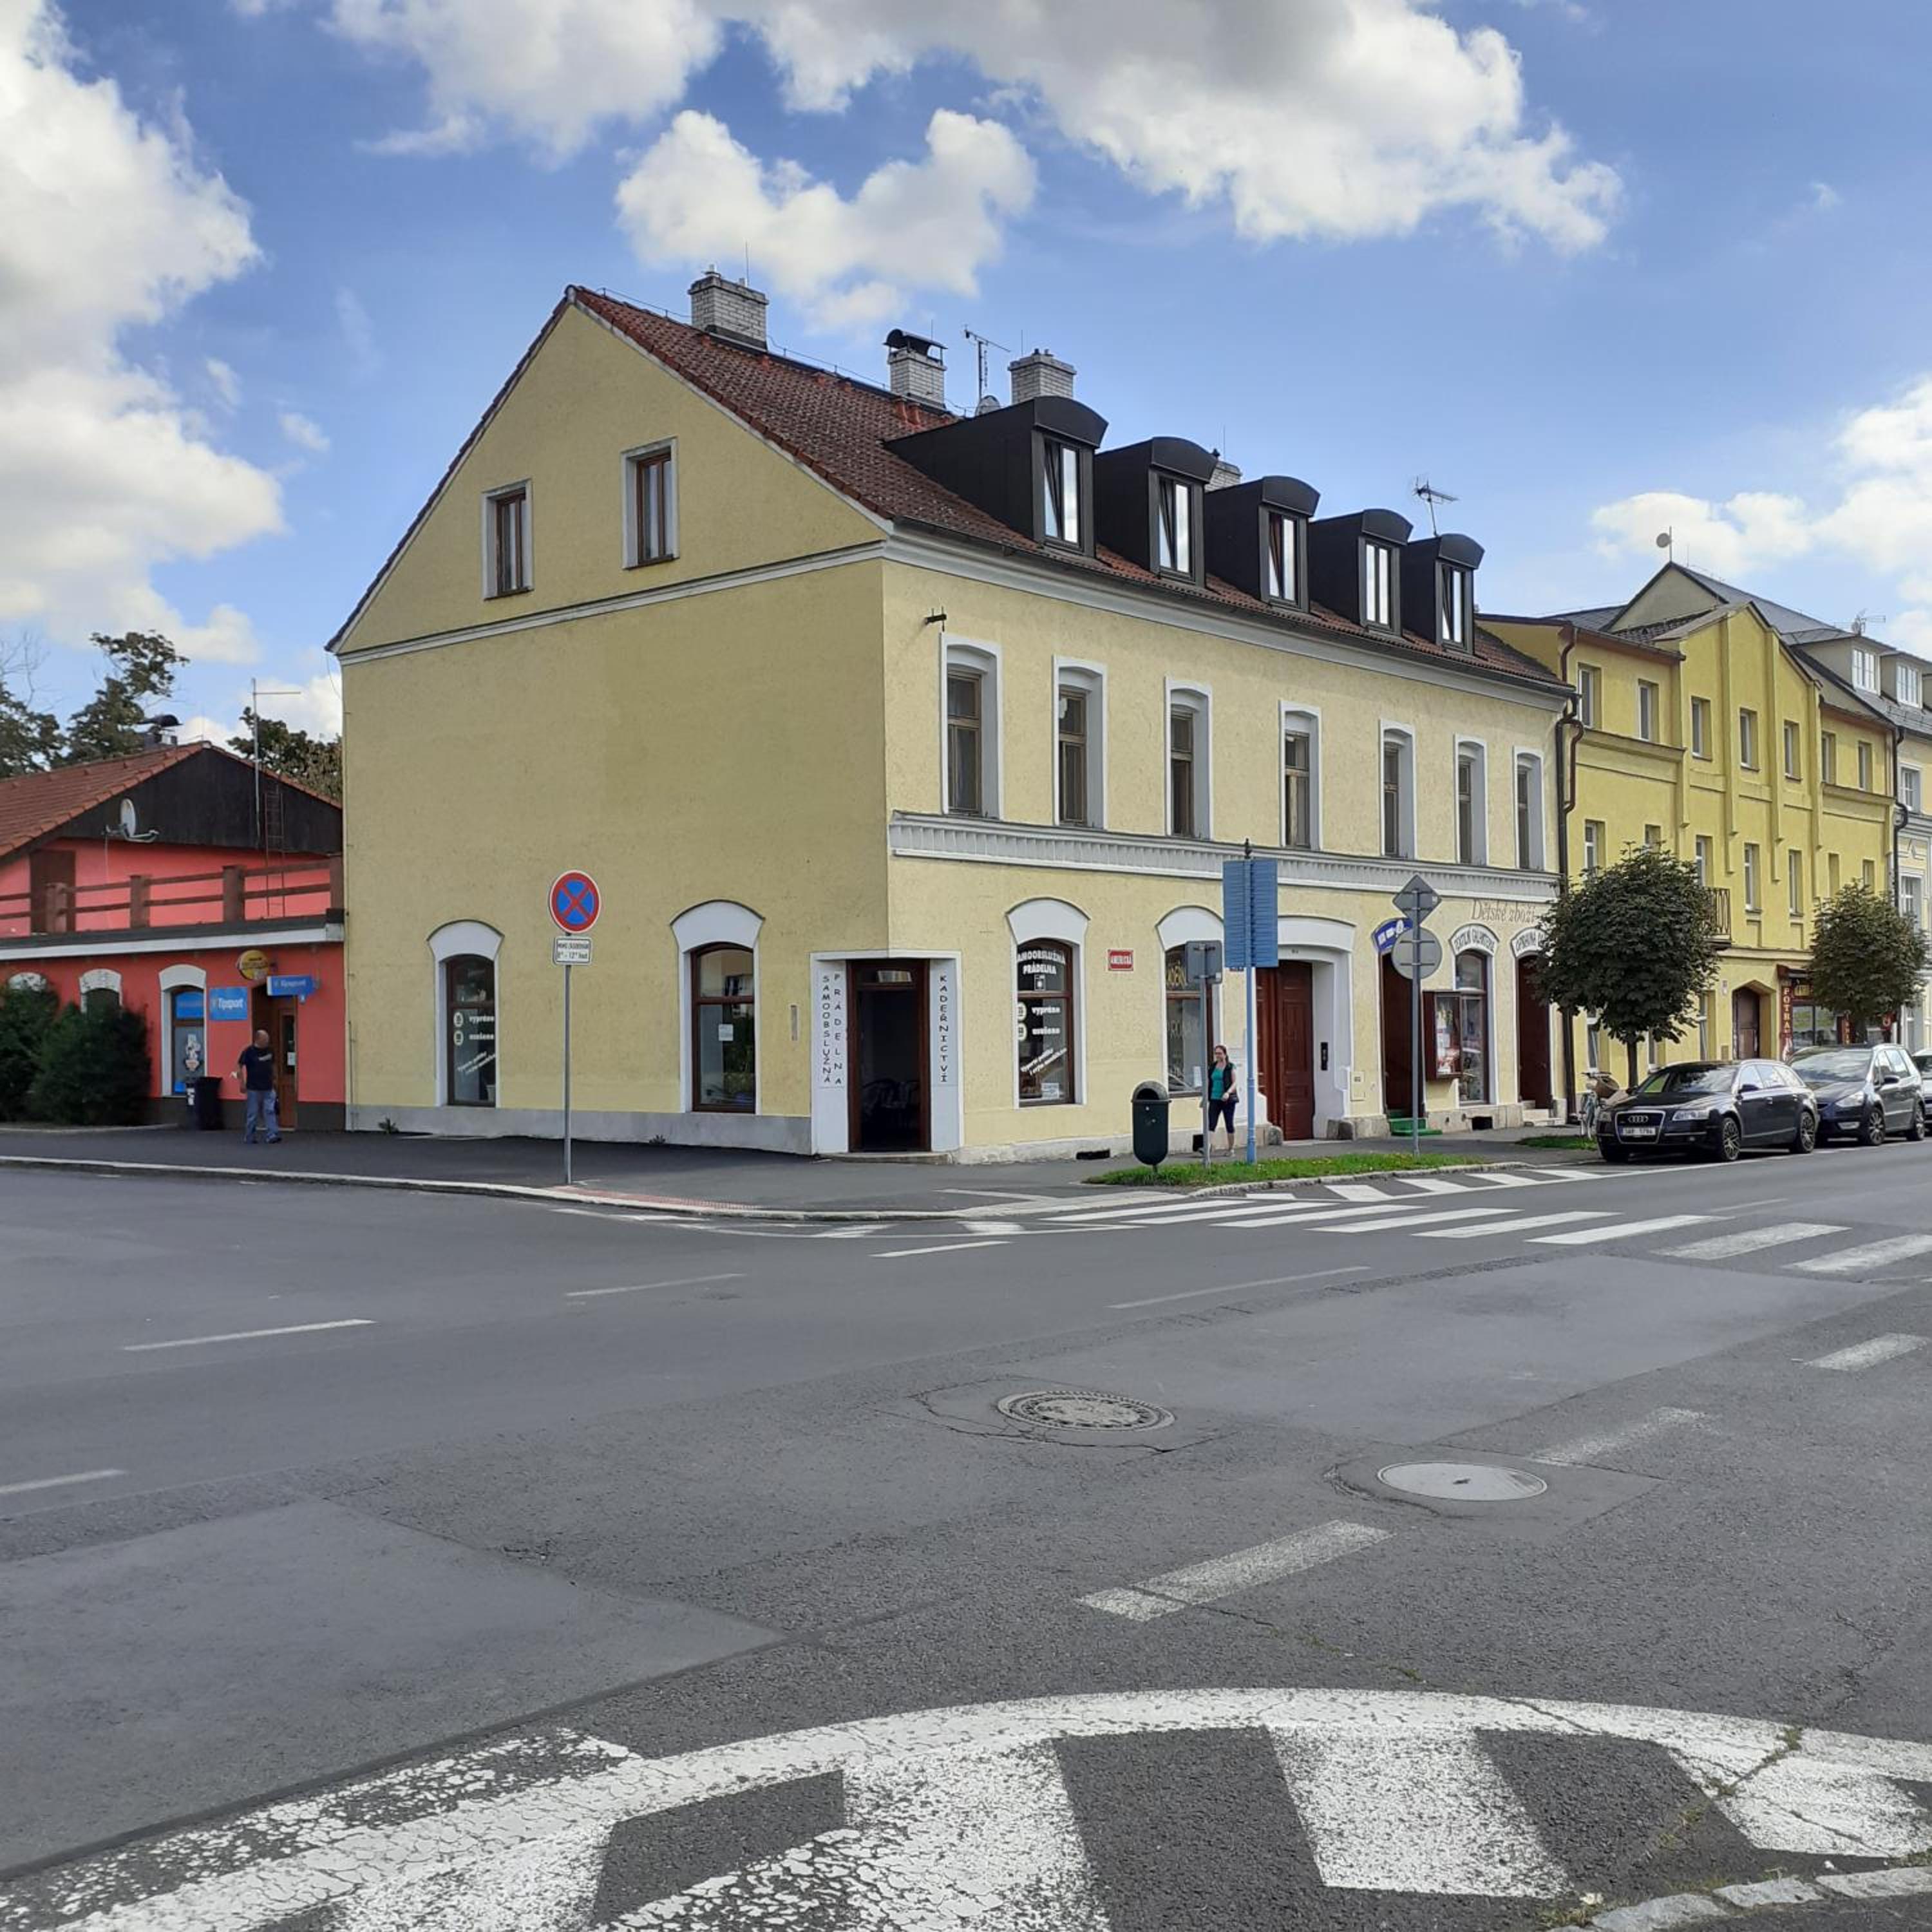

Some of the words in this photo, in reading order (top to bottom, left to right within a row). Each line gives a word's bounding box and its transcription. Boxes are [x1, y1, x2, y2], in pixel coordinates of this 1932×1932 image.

[1472, 899, 1507, 922] Dětské
[1018, 950, 1066, 965] AMOOBSLUŽNÁ
[1023, 961, 1057, 975] PRÁDELNA
[218, 998, 244, 1010] Tipsport
